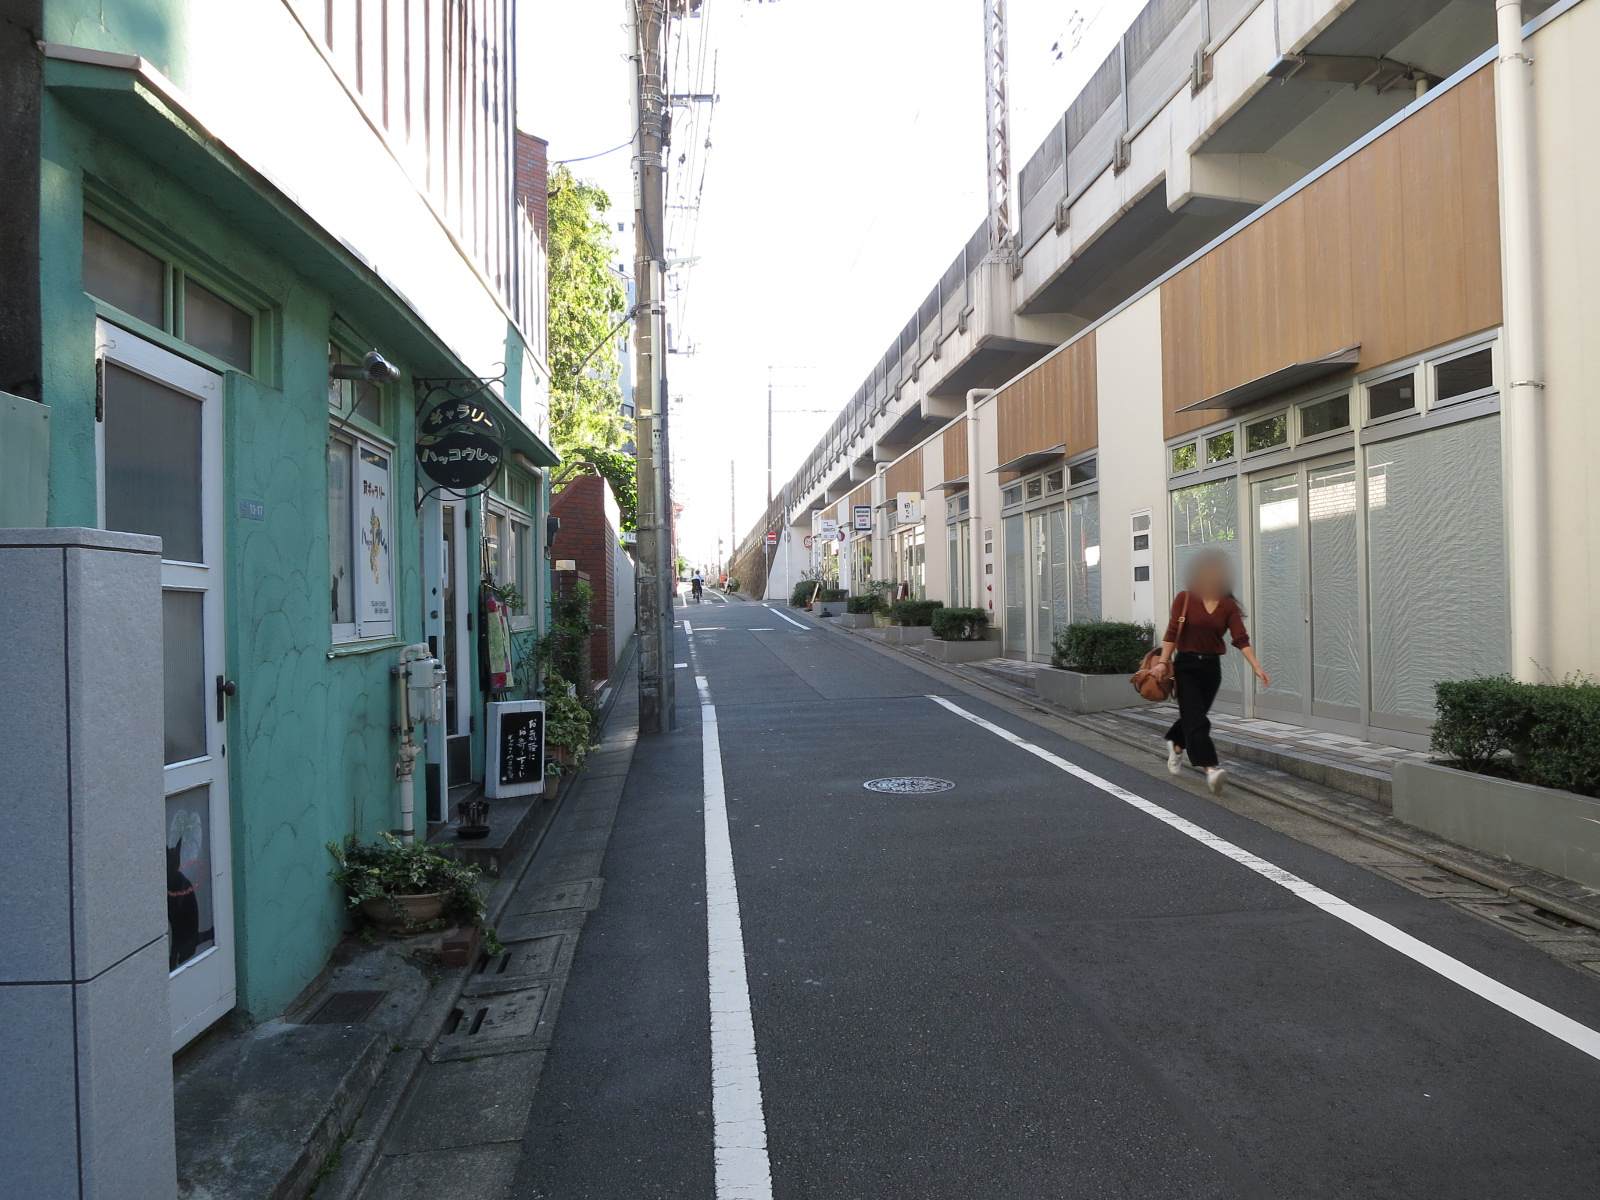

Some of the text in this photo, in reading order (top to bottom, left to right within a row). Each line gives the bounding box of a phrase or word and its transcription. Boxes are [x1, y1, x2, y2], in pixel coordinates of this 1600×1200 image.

[429, 403, 493, 427] ギャラリー
[421, 447, 498, 465] ハッコウしゃ
